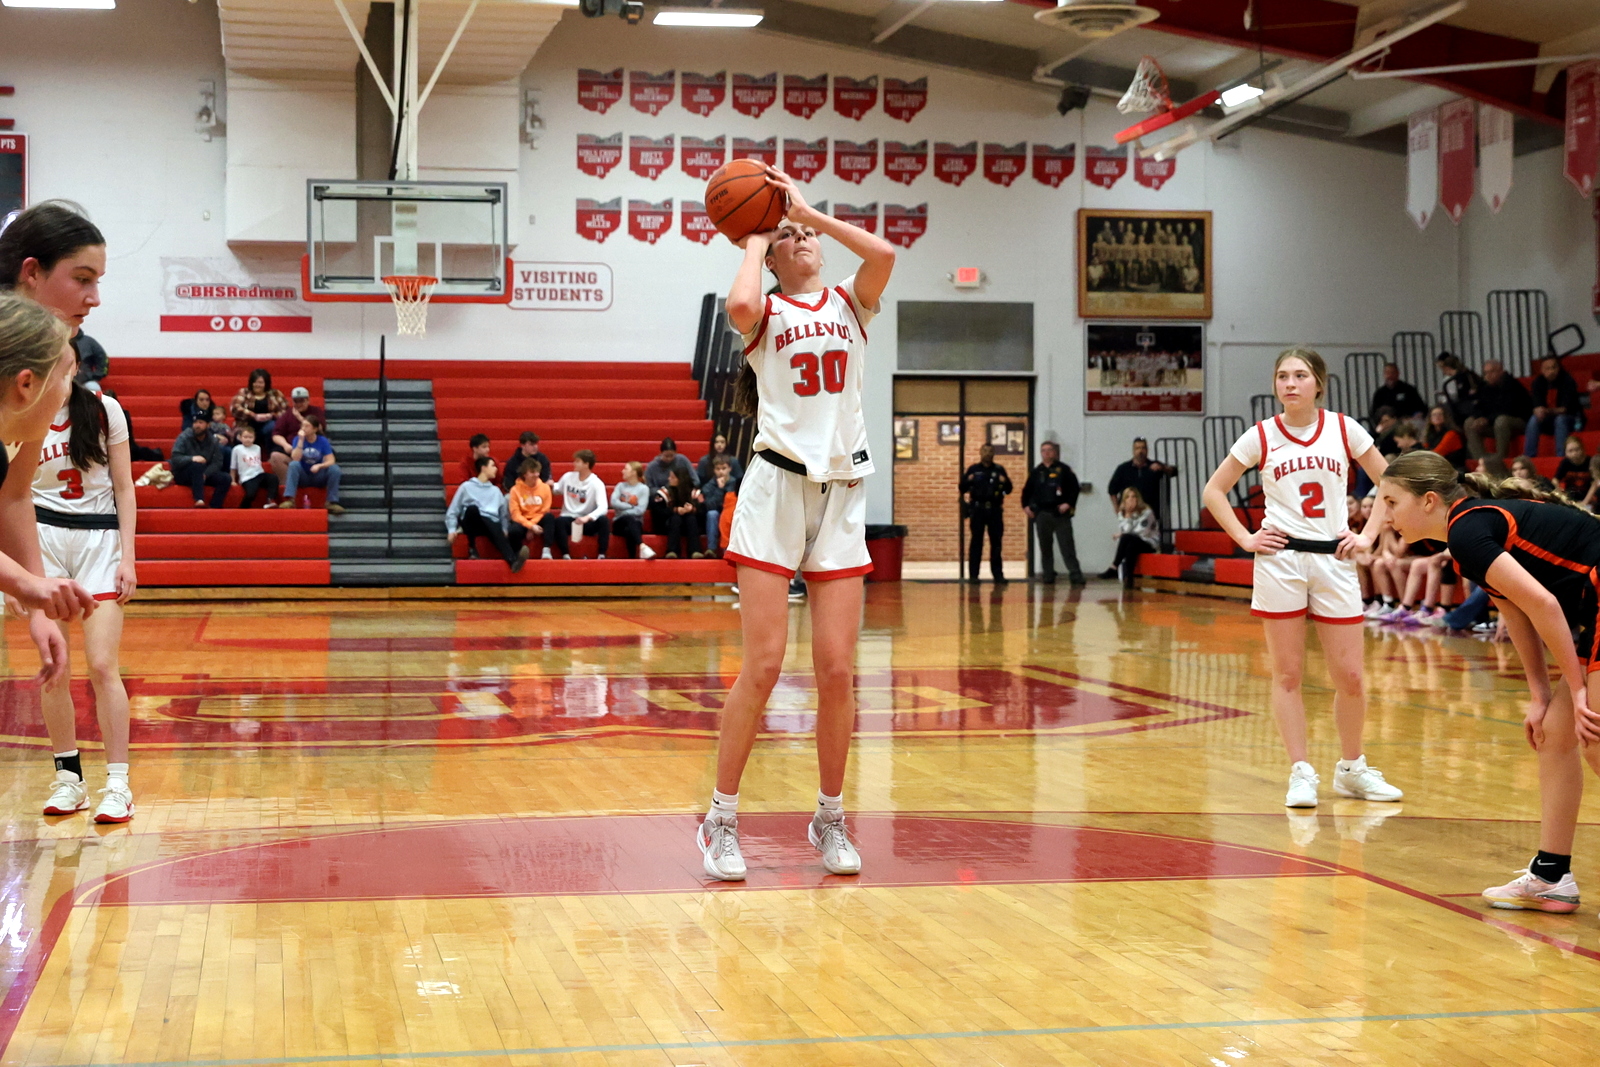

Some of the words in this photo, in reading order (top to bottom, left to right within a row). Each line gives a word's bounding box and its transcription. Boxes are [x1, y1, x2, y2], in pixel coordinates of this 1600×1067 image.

[1, 138, 16, 149] PTS
[520, 270, 598, 284] VISITING
[176, 285, 296, 300] @BHSRedmen
[514, 287, 604, 302] STUDENTS
[790, 349, 849, 398] 30
[1273, 456, 1342, 482] BELLEVUE
[57, 468, 85, 500] 3
[1299, 481, 1326, 518] 2
